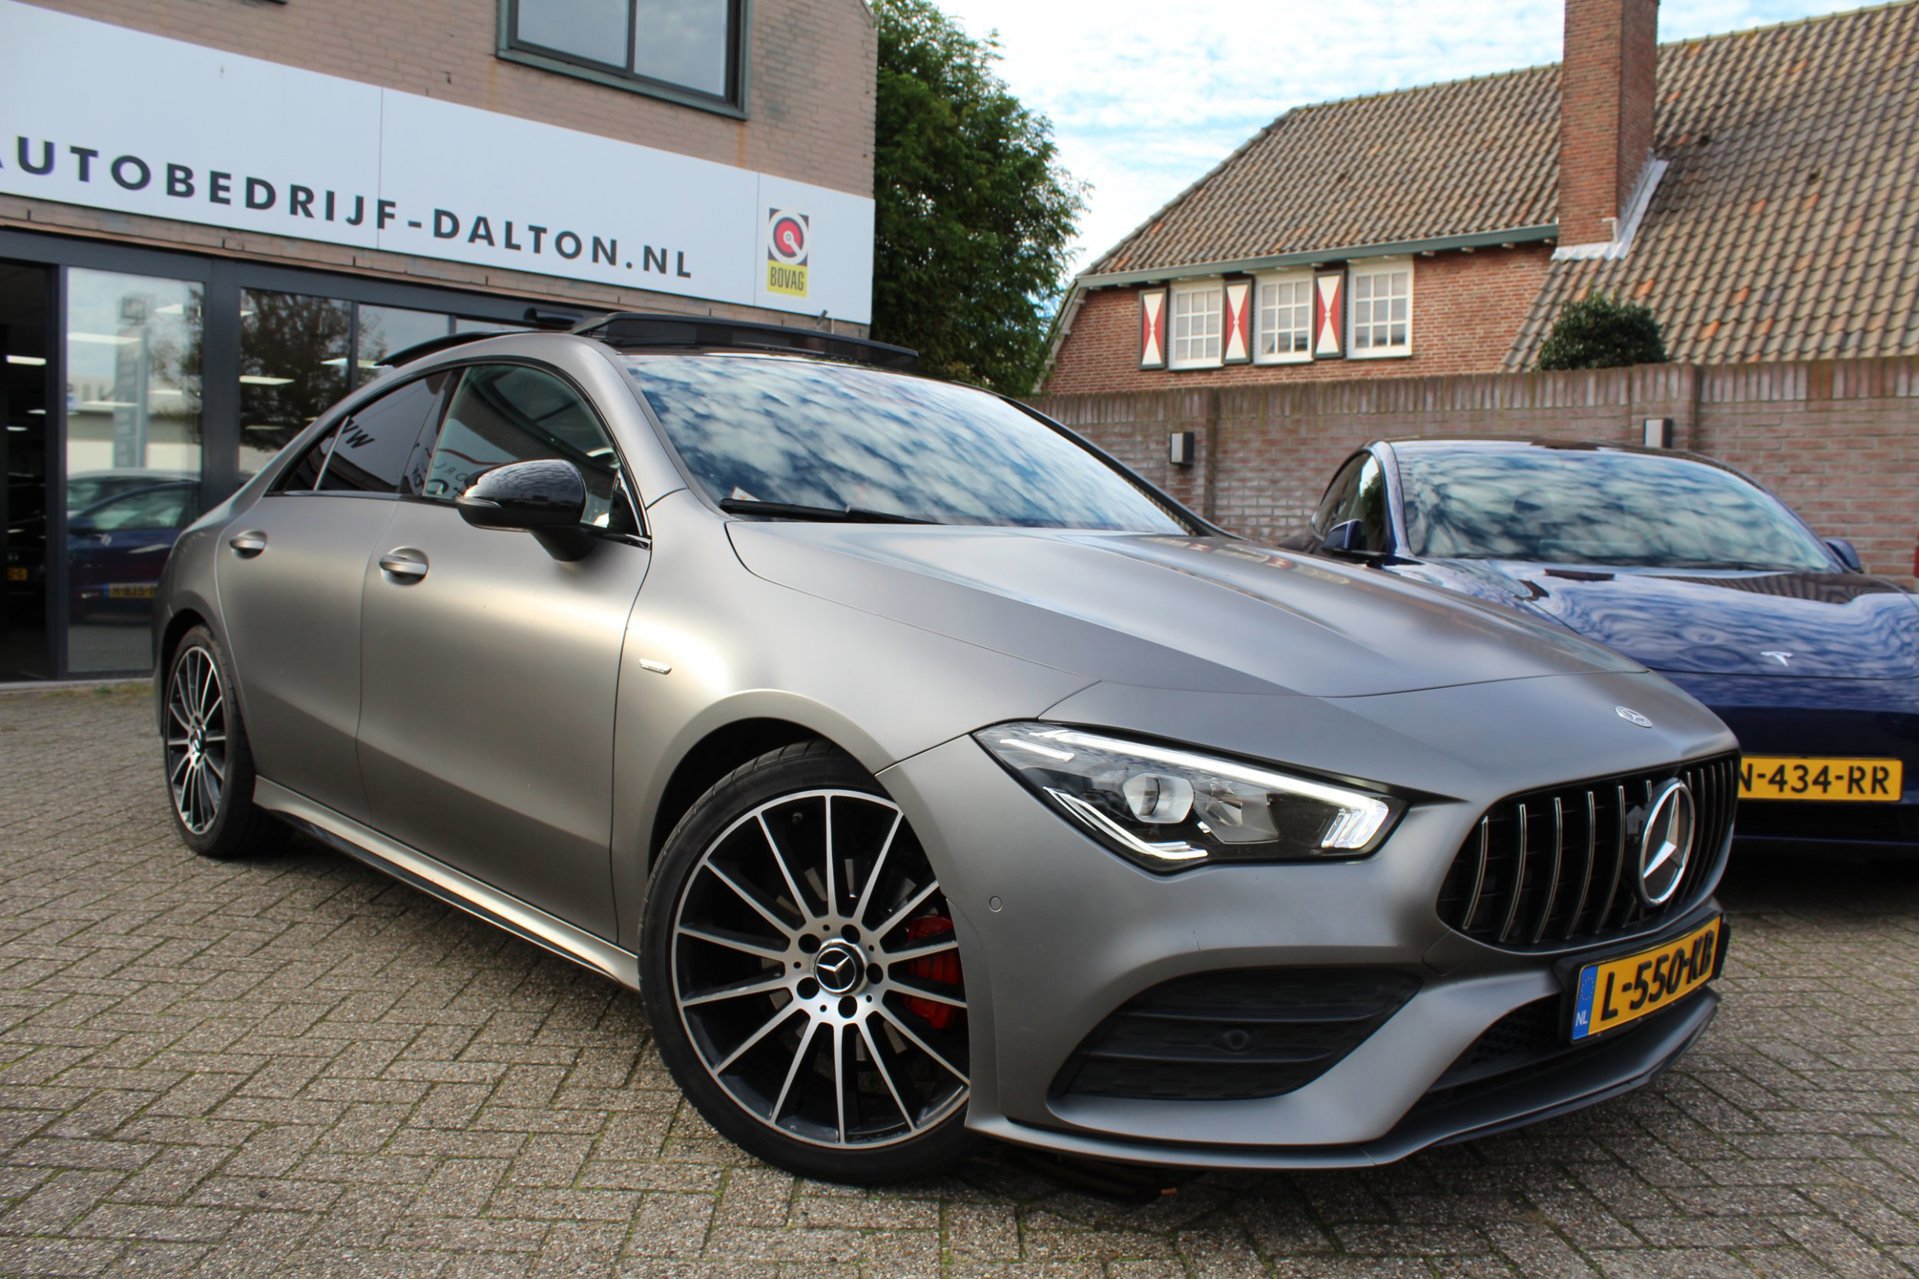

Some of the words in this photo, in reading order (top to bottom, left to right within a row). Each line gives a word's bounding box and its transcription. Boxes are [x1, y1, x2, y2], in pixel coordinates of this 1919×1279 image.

[0, 136, 691, 278] UTOBEDRIJF-DALTON.NL
[770, 266, 804, 291] BOVAG
[1739, 763, 1889, 795] N-434-RR
[1600, 929, 1715, 1021] L-550-KB
[1575, 1011, 1588, 1027] NL
